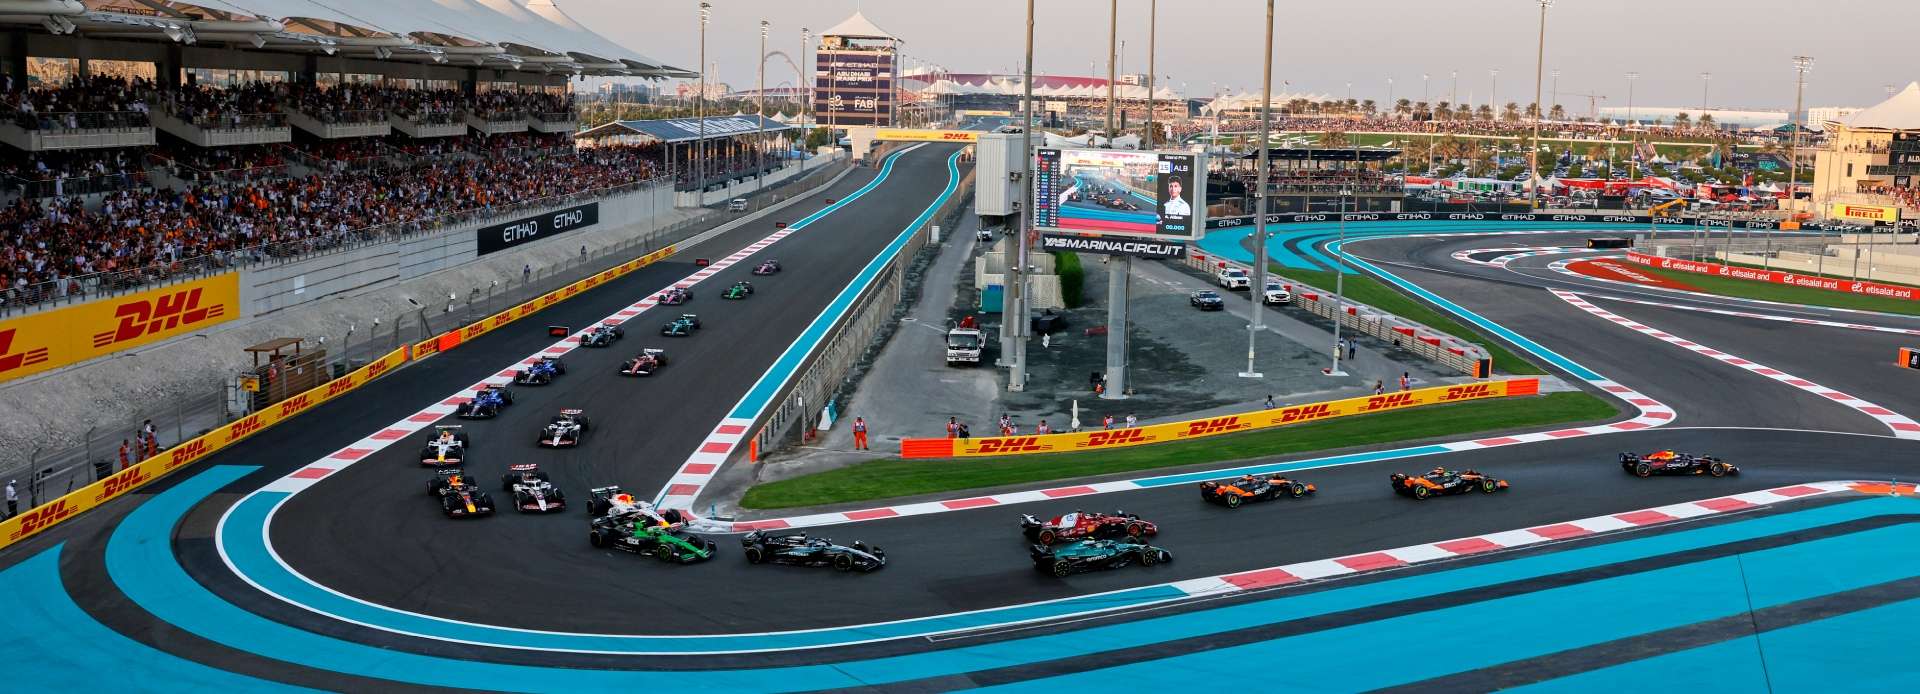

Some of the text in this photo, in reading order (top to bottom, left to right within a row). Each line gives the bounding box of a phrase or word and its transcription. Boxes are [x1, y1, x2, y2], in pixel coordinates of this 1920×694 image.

[854, 99, 874, 108] FAB
[554, 210, 583, 229] ETIHAD
[1294, 214, 1326, 222] ETIHAD
[1845, 206, 1884, 219] PIRELLI
[1219, 218, 1242, 227] ETIHAD
[503, 221, 538, 243] ETIHAD
[1672, 262, 1696, 271] etisalat
[1696, 265, 1708, 273] and
[1731, 269, 1756, 279] etisalat
[1756, 273, 1770, 281] and
[566, 285, 578, 296] DHL
[1796, 277, 1822, 288] etisalat
[1823, 280, 1838, 289] and
[545, 292, 558, 305] DHL
[1865, 285, 1894, 296] etisalat
[1895, 288, 1911, 298] and
[114, 288, 208, 343] DHL
[521, 302, 536, 315] DHL
[495, 312, 511, 326] DHL
[467, 322, 484, 337] DHL
[368, 359, 388, 376] DHL
[328, 376, 353, 397] DHL
[1447, 384, 1491, 400] DHL
[281, 395, 309, 417] DHL
[1368, 392, 1414, 410] DHL
[1281, 404, 1331, 422] DHL
[231, 415, 261, 440] DHL
[1188, 416, 1241, 436] DHL
[978, 437, 1041, 453] DHL
[1088, 428, 1145, 446] DHL
[172, 439, 206, 467] DHL
[103, 466, 144, 498] DHL
[20, 499, 70, 537] DHL
[1086, 554, 1107, 562] aramco
